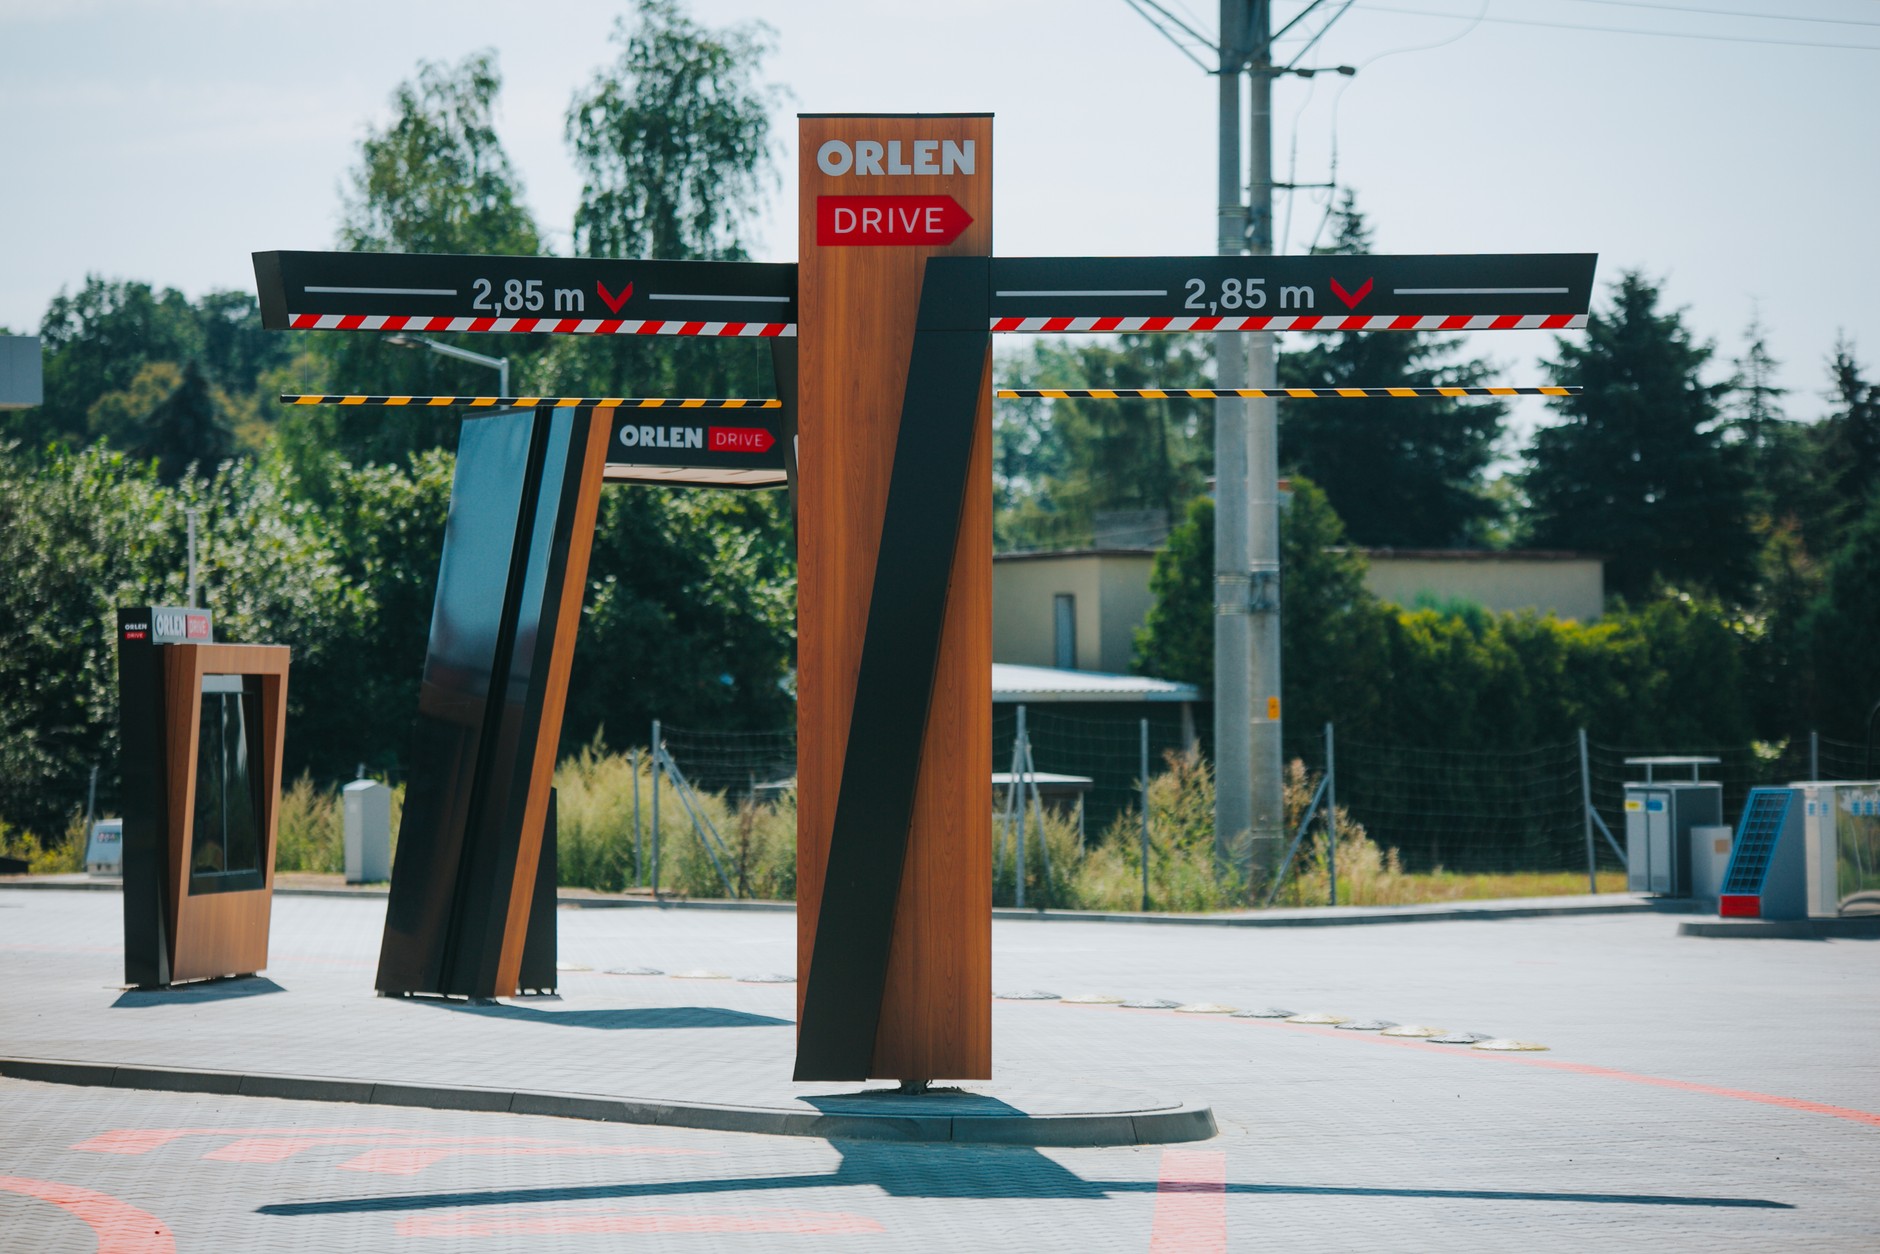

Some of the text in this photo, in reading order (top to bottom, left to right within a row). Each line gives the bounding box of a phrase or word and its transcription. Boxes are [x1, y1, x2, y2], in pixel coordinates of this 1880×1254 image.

[817, 139, 976, 177] ORLEN
[834, 207, 944, 233] DRIVE
[472, 277, 585, 317] 2,85 m
[1184, 277, 1315, 316] 2,85 m
[619, 424, 764, 449] ORLEN DRIVE
[155, 614, 206, 637] ORLEN DRIVE
